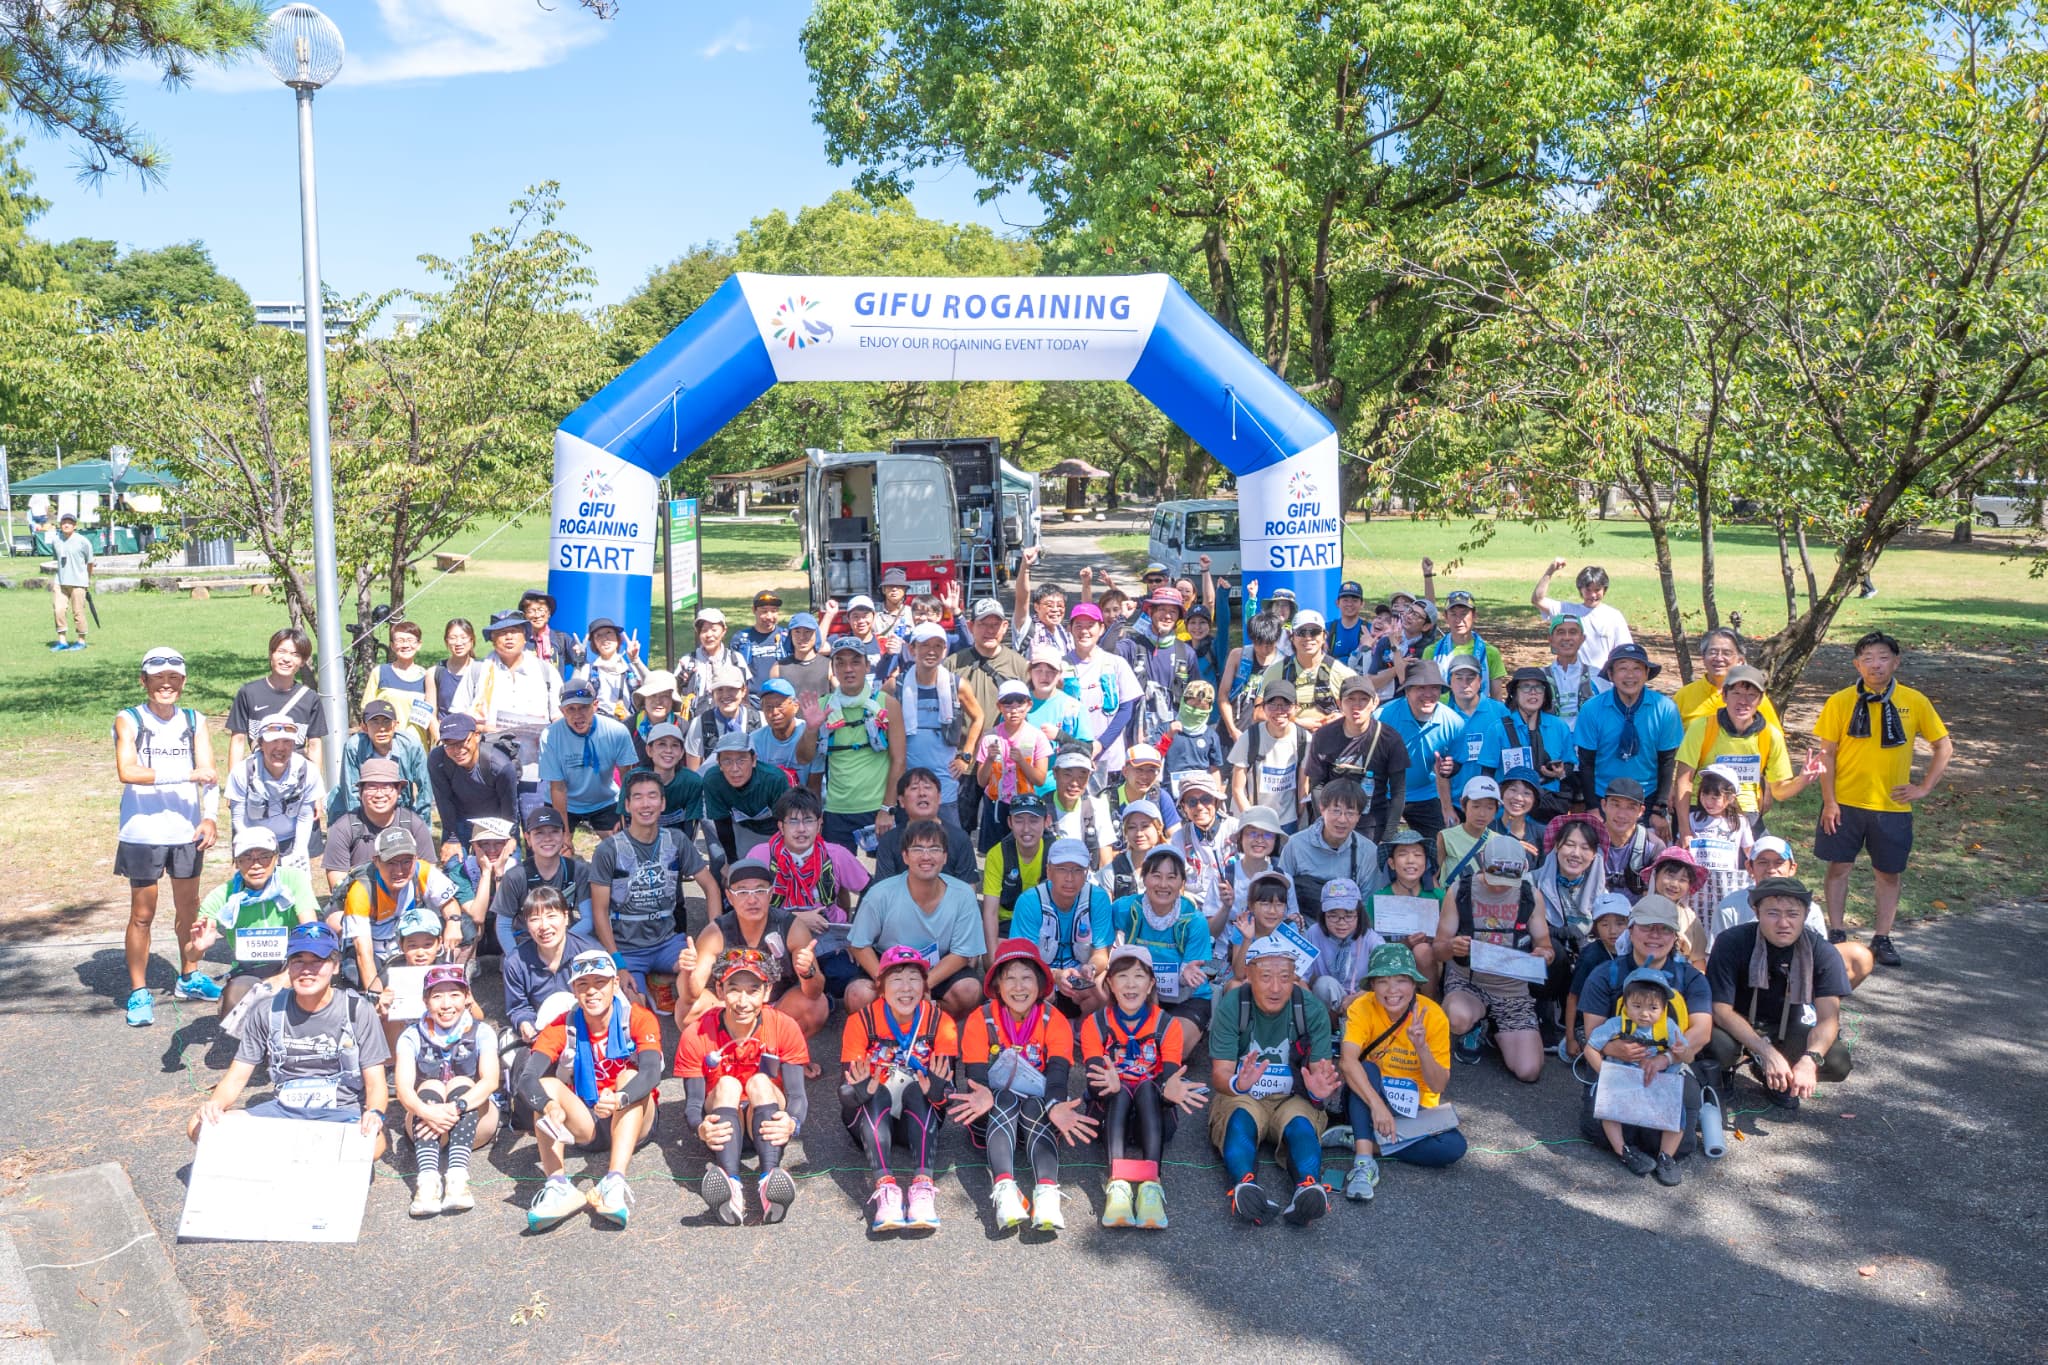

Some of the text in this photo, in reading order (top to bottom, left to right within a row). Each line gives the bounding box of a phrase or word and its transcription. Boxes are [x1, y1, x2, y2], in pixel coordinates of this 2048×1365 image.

[854, 291, 1131, 320] GIFU ROGAINING
[859, 336, 1089, 351] ENJOY OUR ROGAINING EVENT TODAY
[578, 501, 616, 518] GIFU
[1287, 502, 1321, 518] GIFU
[558, 518, 639, 538] ROGAINING
[1264, 518, 1337, 536] ROGAINING
[559, 543, 635, 571] START
[1269, 542, 1337, 569] START
